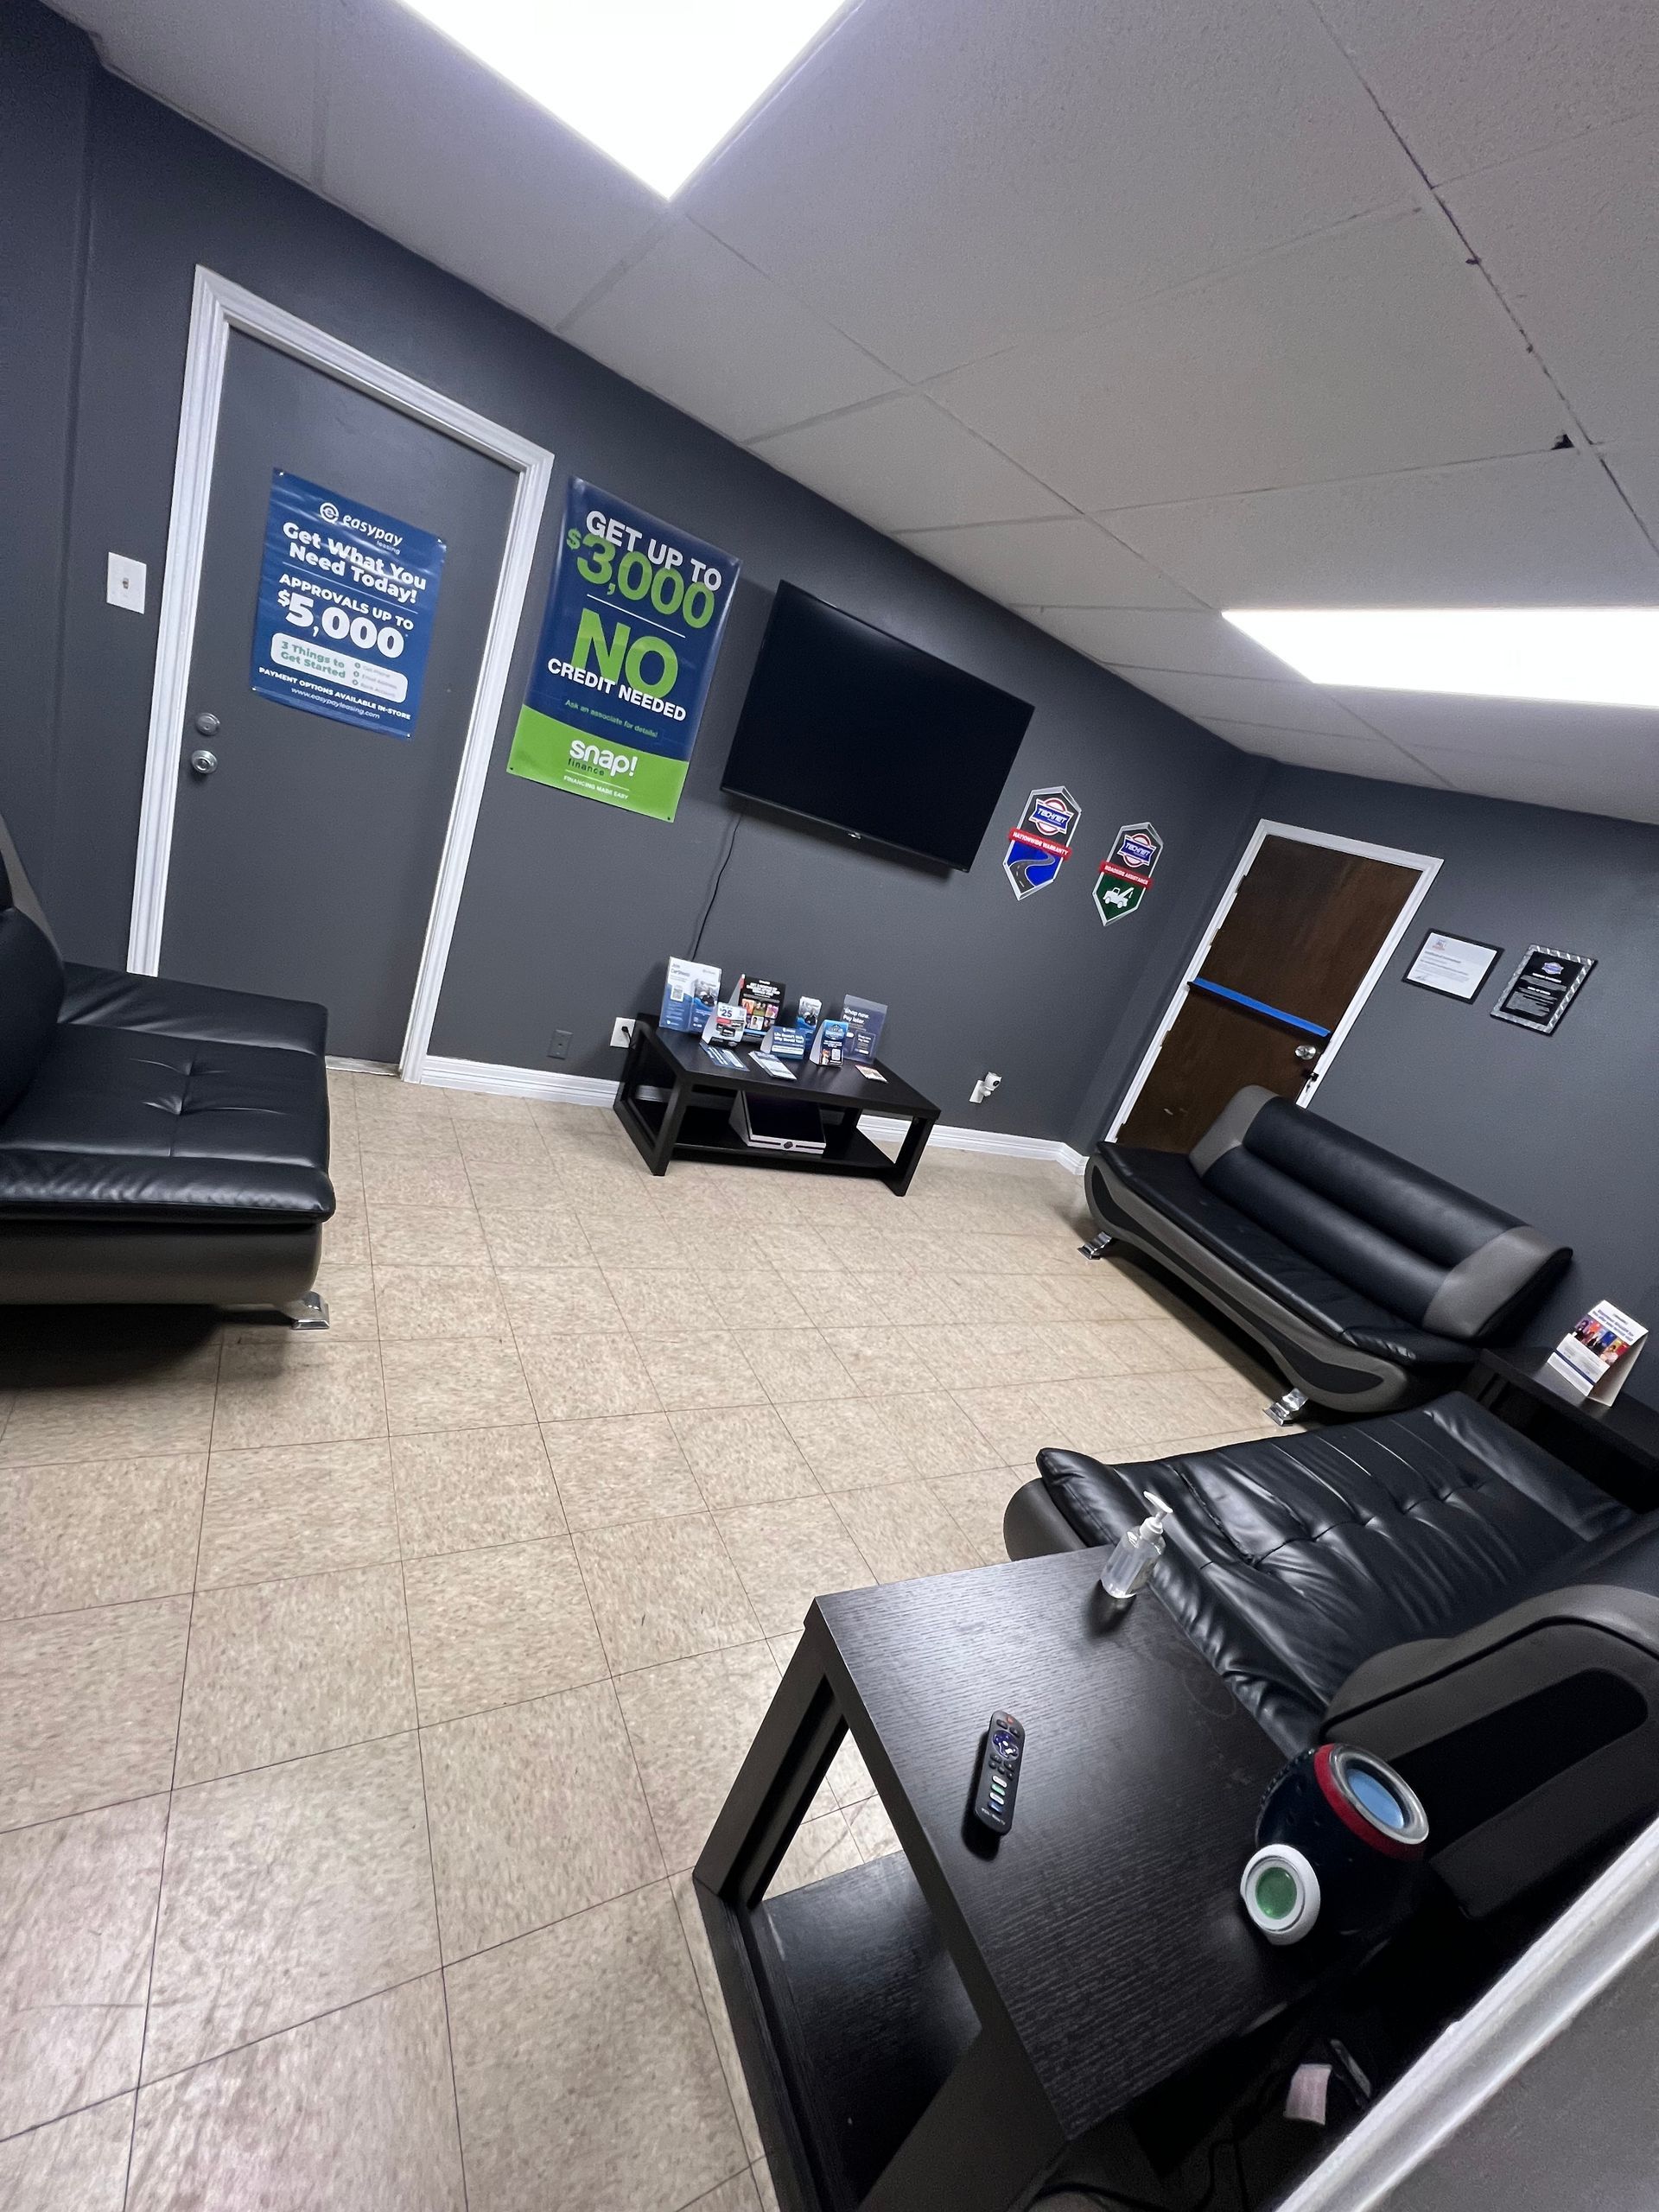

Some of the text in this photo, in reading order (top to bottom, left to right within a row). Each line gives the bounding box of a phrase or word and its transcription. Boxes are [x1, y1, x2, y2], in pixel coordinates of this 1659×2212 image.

[343, 515, 403, 546] easypay
[283, 522, 426, 590] Get What You
[586, 511, 722, 592] GET UP TO
[289, 542, 417, 604] Need Today!
[566, 527, 715, 629] $3,000
[279, 574, 414, 631] APPROVALS UP TO
[281, 641, 345, 669] 3 Things to
[281, 652, 346, 678] Get Started
[570, 607, 678, 701] NO
[258, 667, 411, 720] PAYMENT OPTIONS AVAILABLE IN-STORE
[291, 687, 380, 719] www.easypayleasing.com
[547, 657, 687, 721] CREDIT NEEDED
[565, 699, 579, 710] Ask
[590, 709, 623, 726] associate
[624, 720, 633, 729] for
[568, 758, 605, 776] finance
[569, 740, 639, 777] snap!
[563, 775, 629, 800] FINANCING MADE EASY
[1013, 831, 1069, 855] NATIONWIDE WARRANTY
